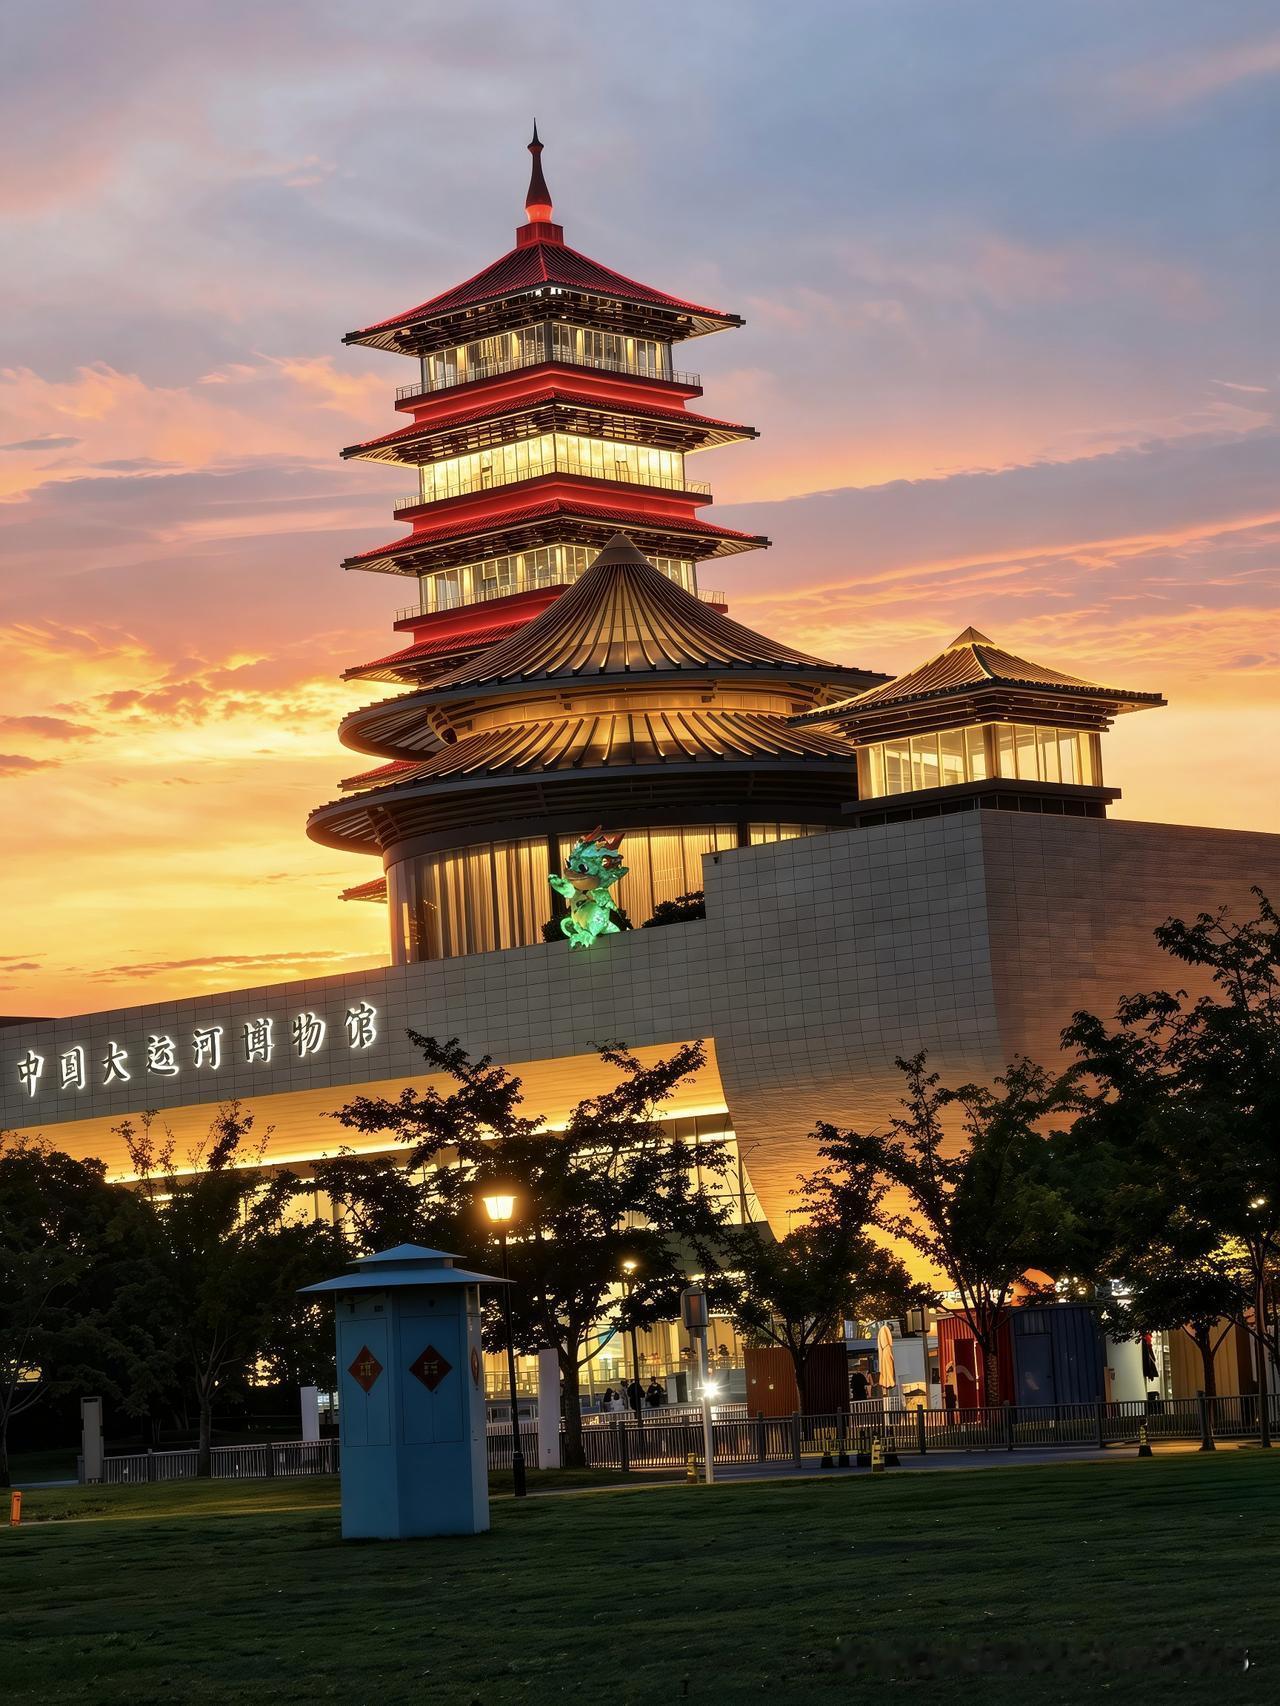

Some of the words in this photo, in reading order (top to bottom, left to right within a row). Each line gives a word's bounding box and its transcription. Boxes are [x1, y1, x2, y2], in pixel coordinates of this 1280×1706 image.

[16, 1002, 377, 1097] 中国大运河博物馆
